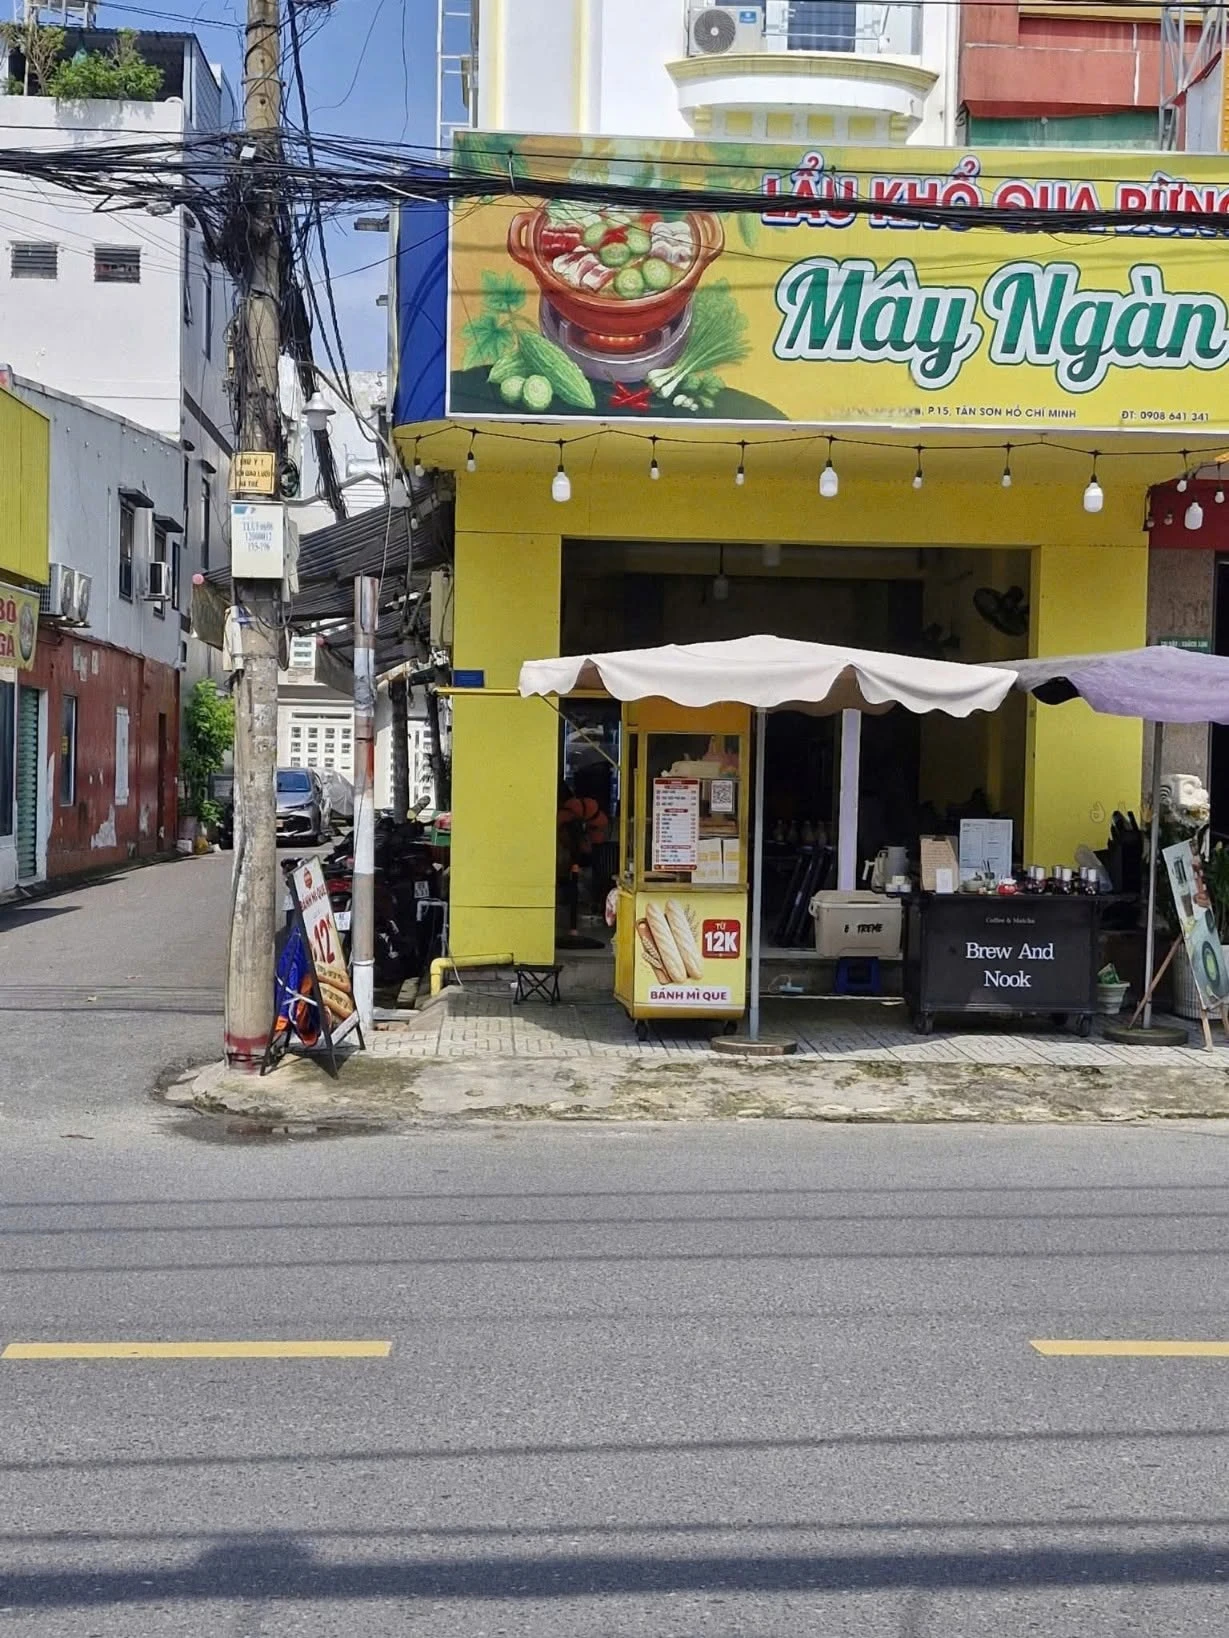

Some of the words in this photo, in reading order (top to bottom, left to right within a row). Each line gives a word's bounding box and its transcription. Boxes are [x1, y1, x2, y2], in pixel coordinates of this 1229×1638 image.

[763, 151, 857, 229] LẨU
[869, 155, 983, 231] KHỔ
[776, 257, 982, 389] Mây
[985, 262, 1229, 393] Ngàn
[955, 404, 976, 416] TÂN
[979, 406, 1002, 416] SƠN
[1025, 407, 1045, 418] CHÍ
[1048, 409, 1077, 419] MINH
[1140, 411, 1166, 421] 0908
[1168, 412, 1187, 421] 641
[1191, 412, 1209, 422] 341
[704, 931, 738, 952] 12K
[965, 942, 1013, 959] Brew
[1017, 942, 1055, 960] And
[983, 970, 1032, 988] Nook
[650, 987, 684, 1000] BÁNH
[702, 991, 728, 1001] QUE
